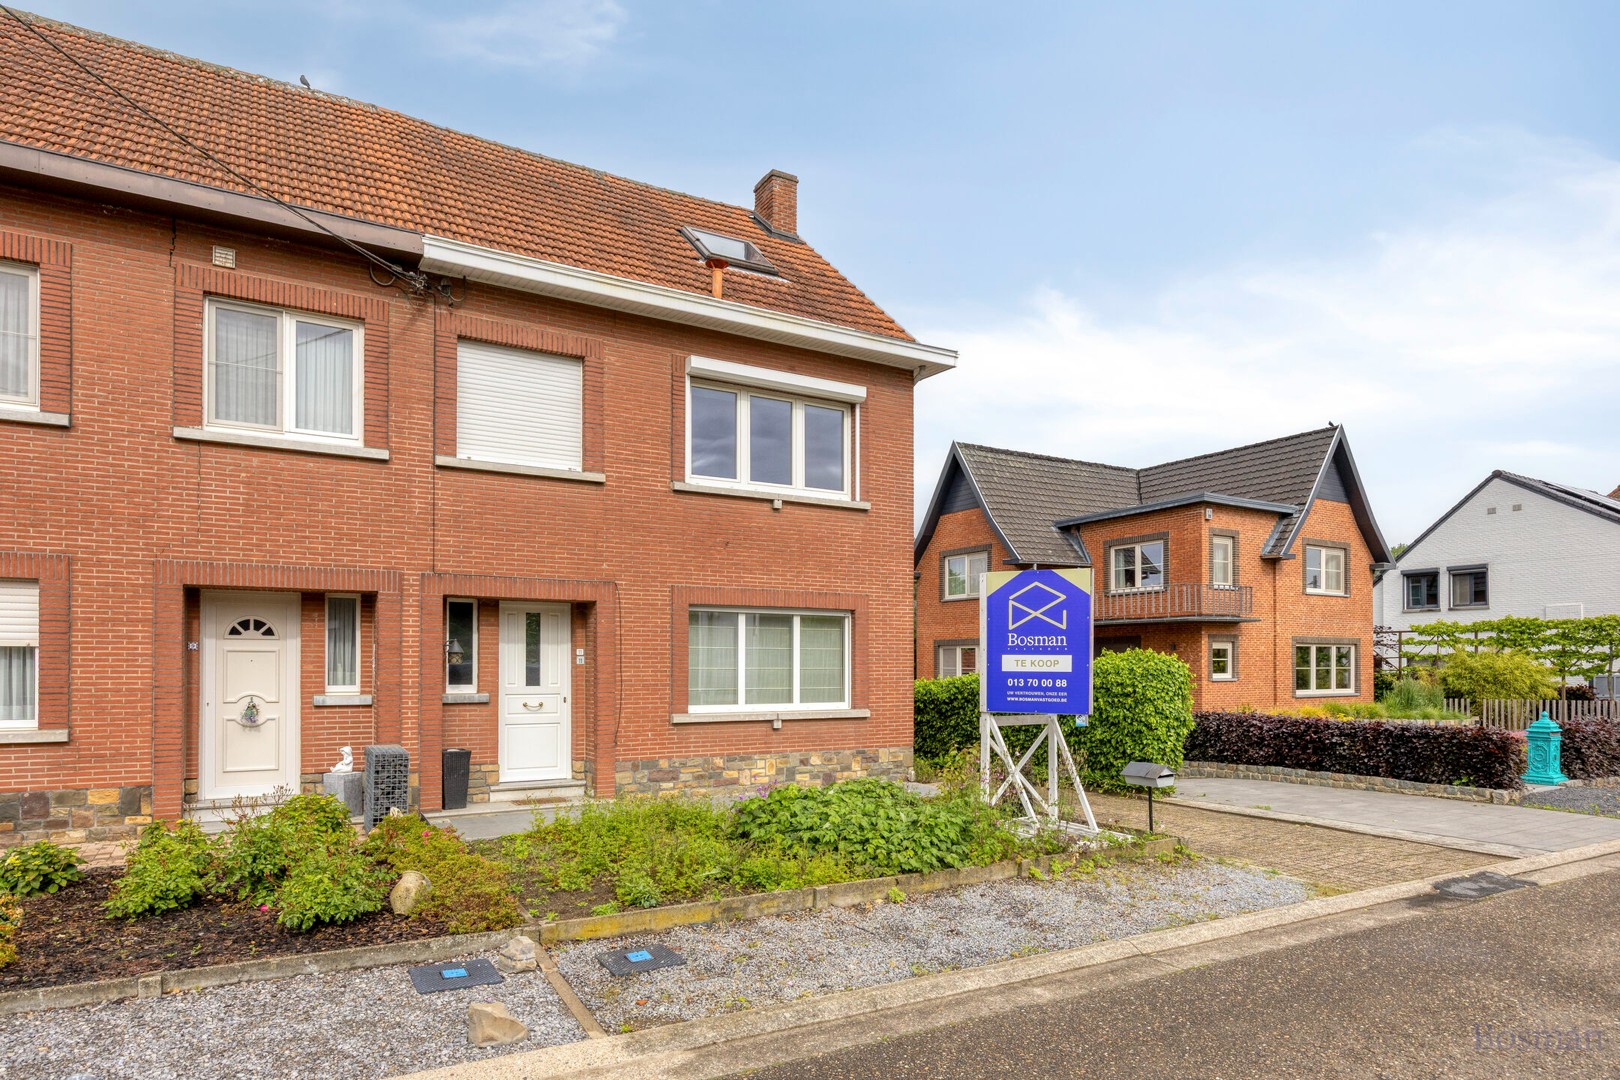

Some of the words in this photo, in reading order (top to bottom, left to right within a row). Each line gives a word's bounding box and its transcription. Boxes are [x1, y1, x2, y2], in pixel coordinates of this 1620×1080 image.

[1007, 633, 1067, 646] Bosman
[1014, 659, 1027, 667] TE
[1007, 678, 1024, 687] 013
[1027, 678, 1038, 687] 70
[1041, 679, 1053, 687] 00
[1055, 679, 1067, 687] 88
